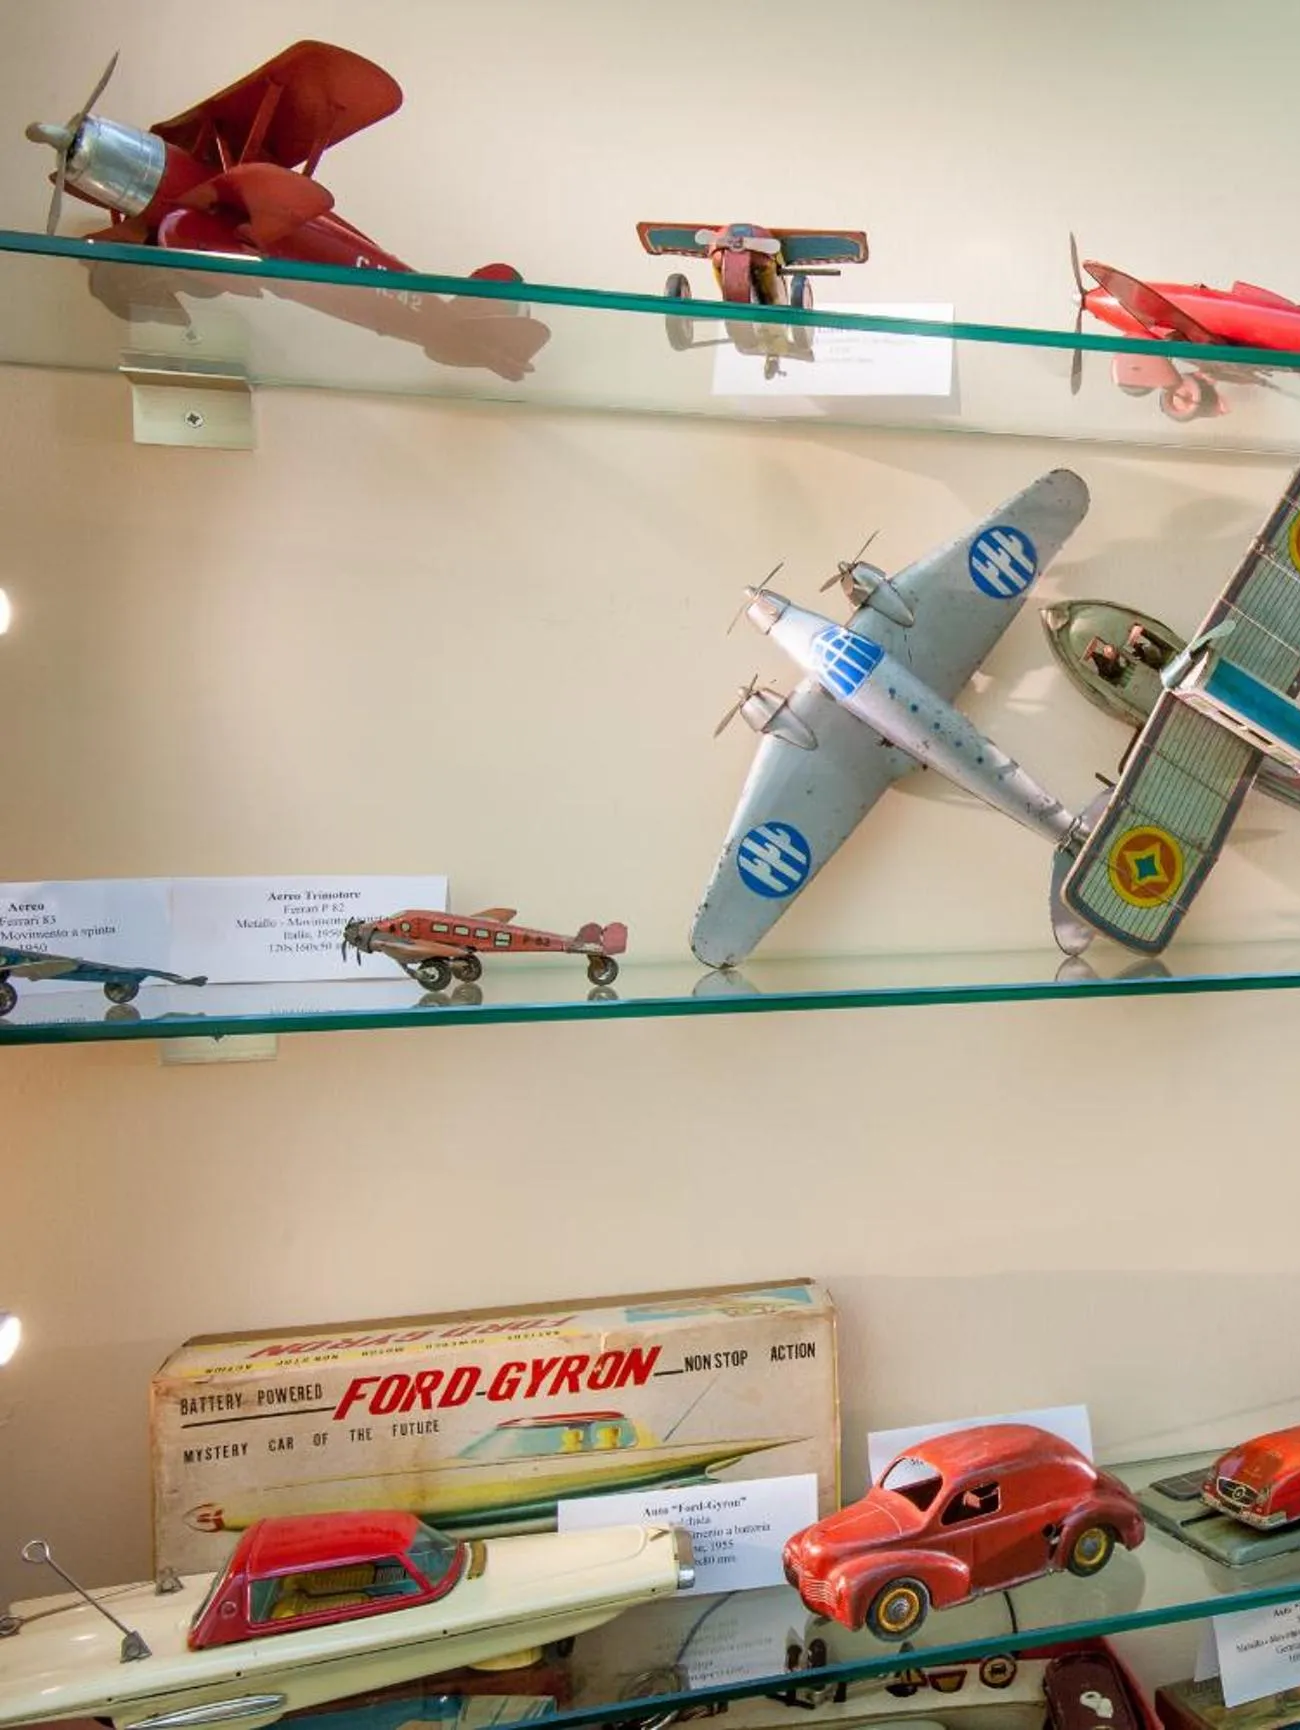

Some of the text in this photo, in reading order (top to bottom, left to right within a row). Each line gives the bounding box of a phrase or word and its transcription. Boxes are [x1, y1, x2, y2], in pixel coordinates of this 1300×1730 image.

[268, 890, 361, 901] Aereo Trimotore
[8, 903, 45, 912] Aereo
[1, 928, 69, 941] Movimento
[82, 926, 116, 938] spinta
[180, 1342, 816, 1421] BATTERY POWERED FORD-GYRON NON STOP ACTION
[183, 1419, 440, 1464] MYSTERY CAR OF THE FUTURE
[643, 1496, 747, 1517] Auto "Ford-Gyron"
[692, 1528, 724, 1539] mento
